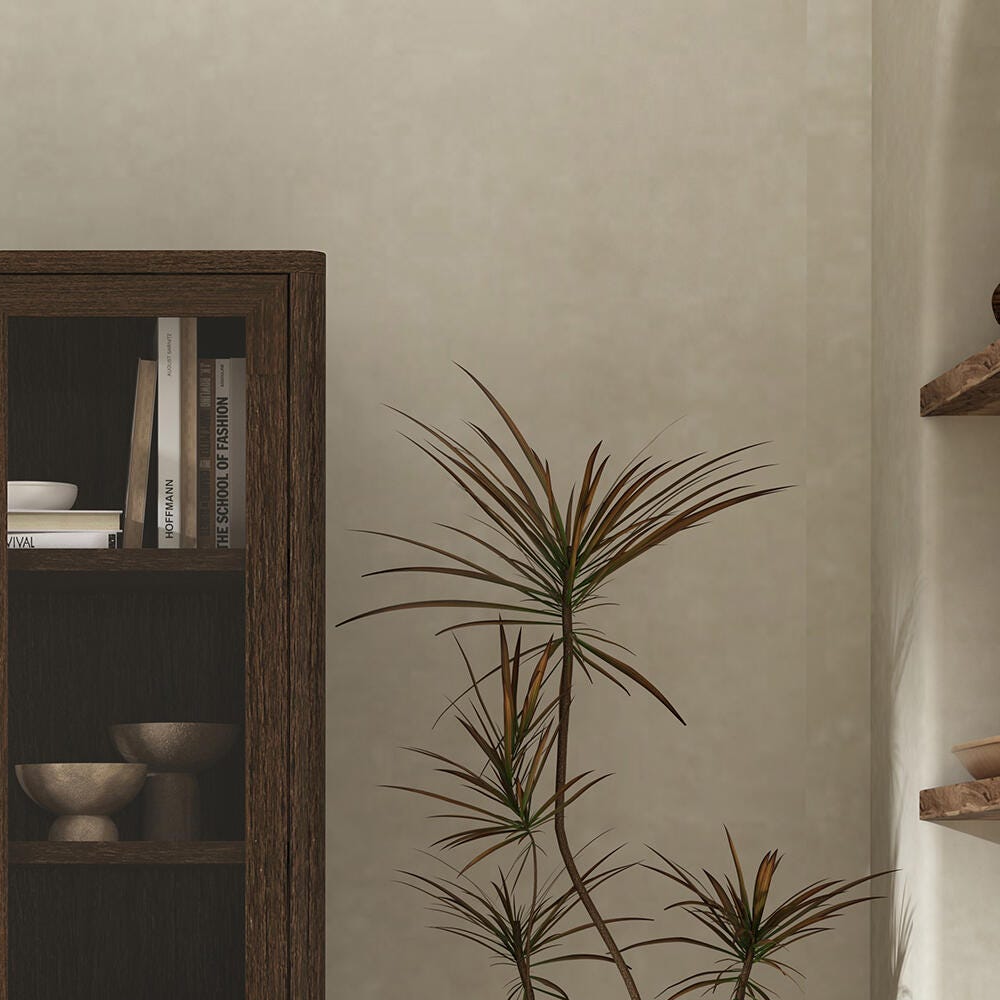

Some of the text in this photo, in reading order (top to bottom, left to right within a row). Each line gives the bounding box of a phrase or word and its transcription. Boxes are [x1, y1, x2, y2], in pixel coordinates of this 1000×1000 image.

[216, 396, 229, 450] FASHION
[216, 454, 229, 470] OF
[165, 479, 174, 539] HOFFMANN
[216, 473, 229, 524] SCHOOL
[216, 527, 229, 549] THE
